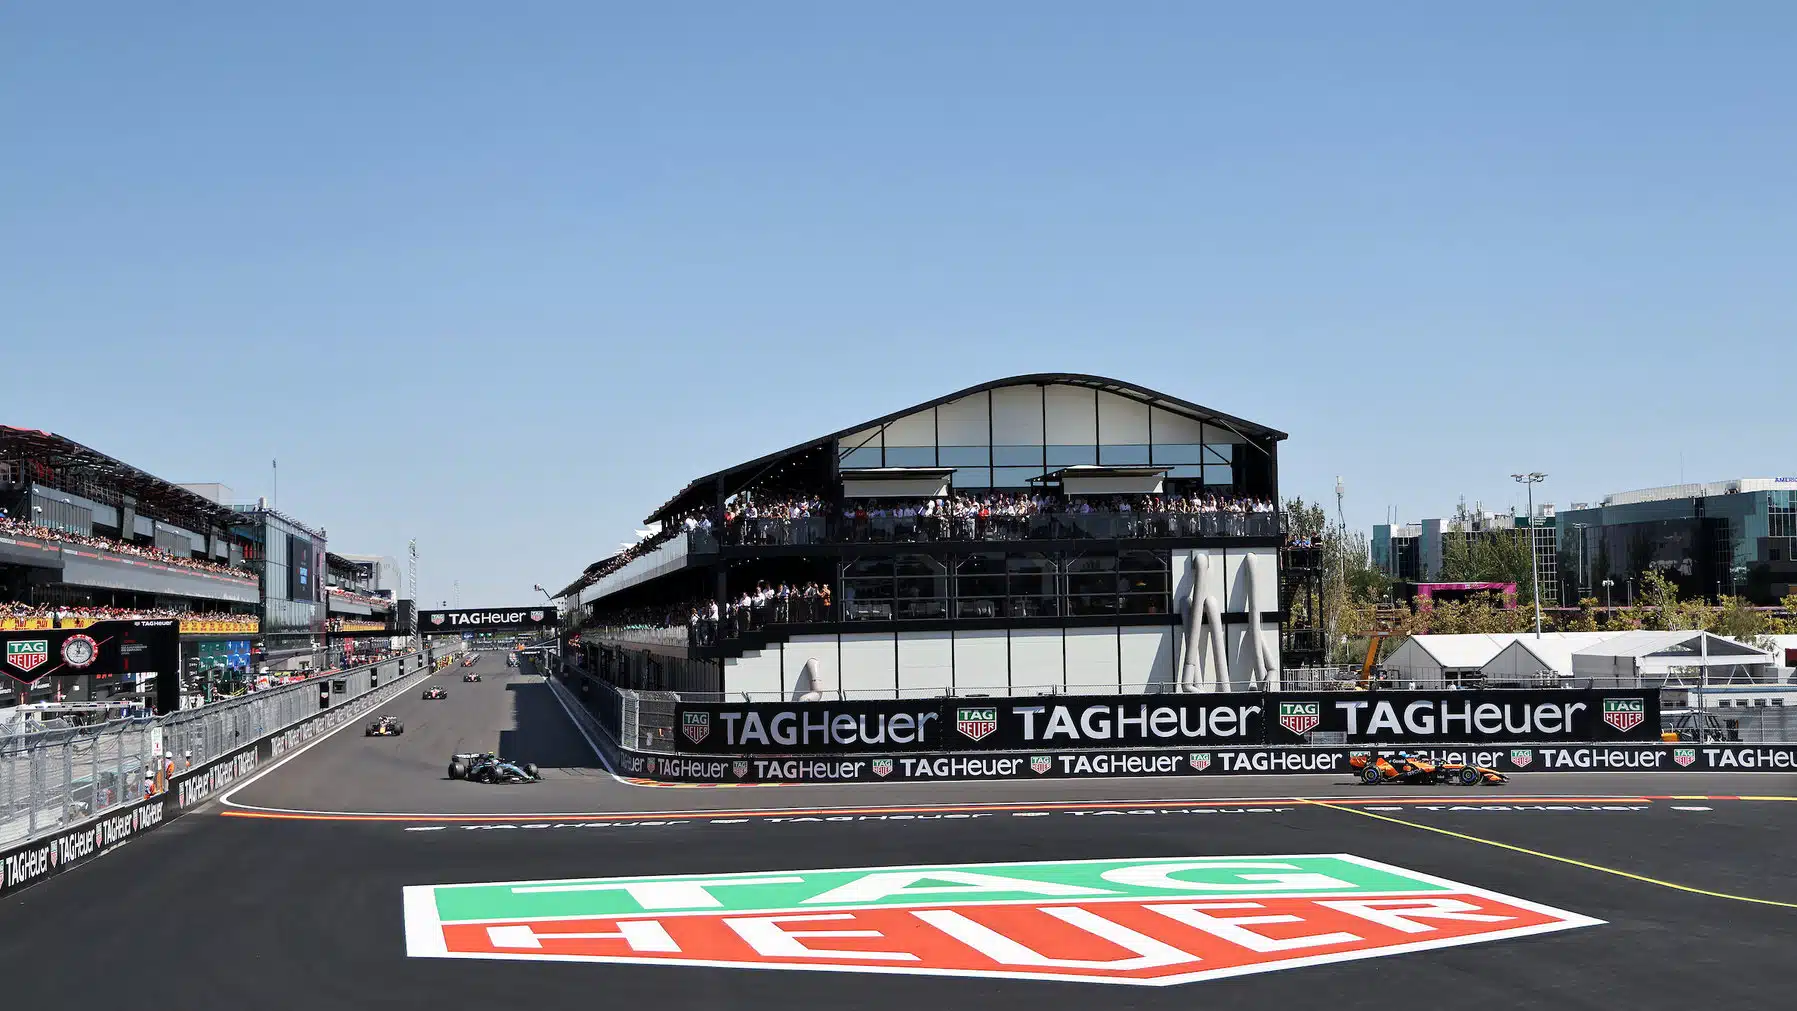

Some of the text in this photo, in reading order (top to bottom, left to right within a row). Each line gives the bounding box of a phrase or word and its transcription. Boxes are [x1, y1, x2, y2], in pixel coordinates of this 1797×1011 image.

[449, 612, 526, 625] TAGHeuer
[9, 642, 44, 651] TAG
[9, 654, 46, 668] HEUER
[960, 708, 994, 720] TAG
[1283, 703, 1317, 714] TAG
[1607, 700, 1642, 711] TAG
[686, 712, 707, 725] TAG
[1013, 704, 1261, 741] TAGHeuer
[1281, 716, 1319, 734] HEUER
[1336, 700, 1587, 736] TAGHeuer
[1605, 713, 1643, 731] HEUER
[684, 725, 709, 742] HEUER
[720, 711, 939, 746] TAGHeuer
[958, 722, 996, 740] HEUER
[1218, 752, 1343, 771] TAGHeuer
[1514, 749, 1532, 757] TAG
[1539, 749, 1667, 768] TAGHeuer
[658, 759, 728, 778] TAGHeuer
[754, 760, 865, 779] TAGHeuer
[900, 758, 1023, 777] TAGHeuer
[1059, 755, 1183, 774] TAGHeuer
[185, 773, 210, 807] TAGHeuer
[138, 801, 163, 829] TAGHeuer
[102, 813, 133, 845] TAGHeuer
[59, 829, 95, 865] TAGHeuer
[6, 846, 49, 887] TAGHeuer
[511, 862, 1361, 909] TAG
[485, 900, 1518, 970] HEUER
